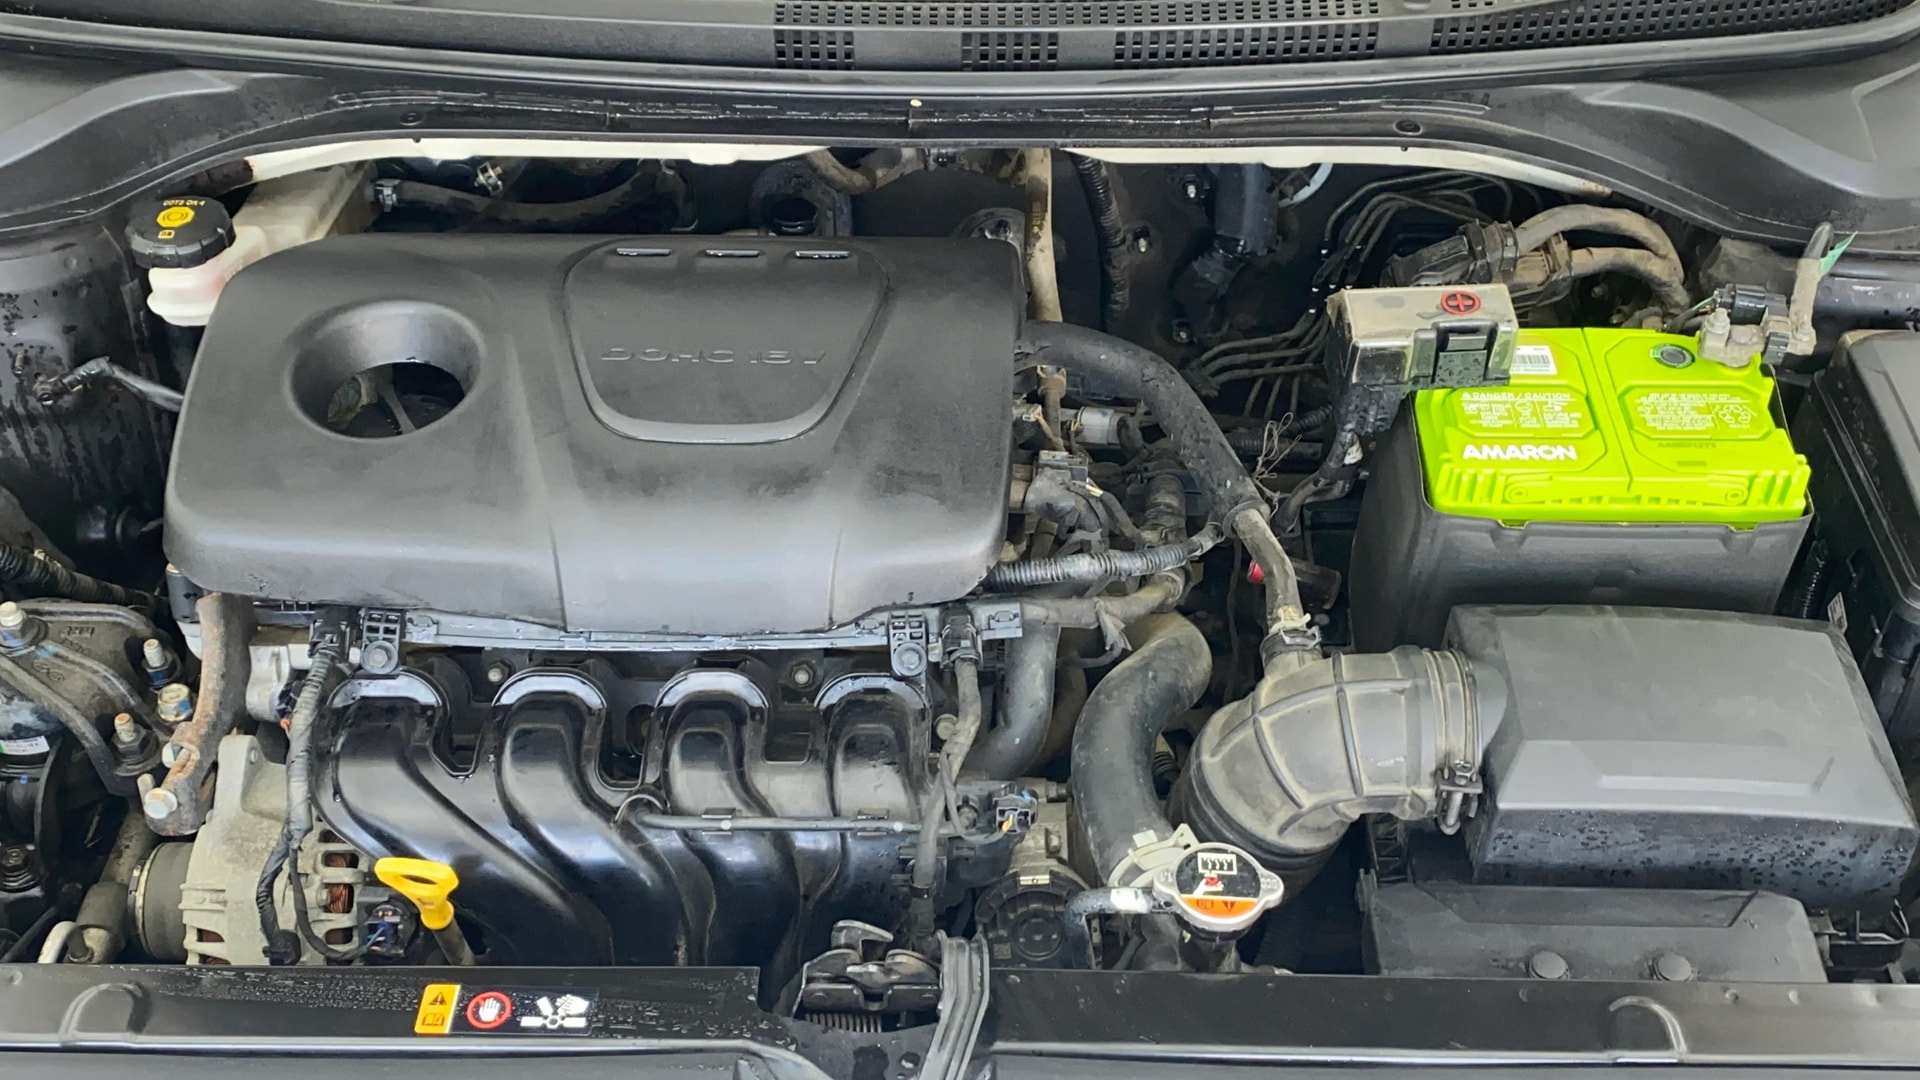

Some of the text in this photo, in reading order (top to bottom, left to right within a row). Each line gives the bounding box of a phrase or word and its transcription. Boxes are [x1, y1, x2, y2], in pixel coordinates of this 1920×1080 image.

[600, 347, 735, 363] DOHC
[1472, 392, 1514, 400] DANGER
[1524, 392, 1571, 400] CAUTION
[1462, 444, 1578, 461] AMARON
